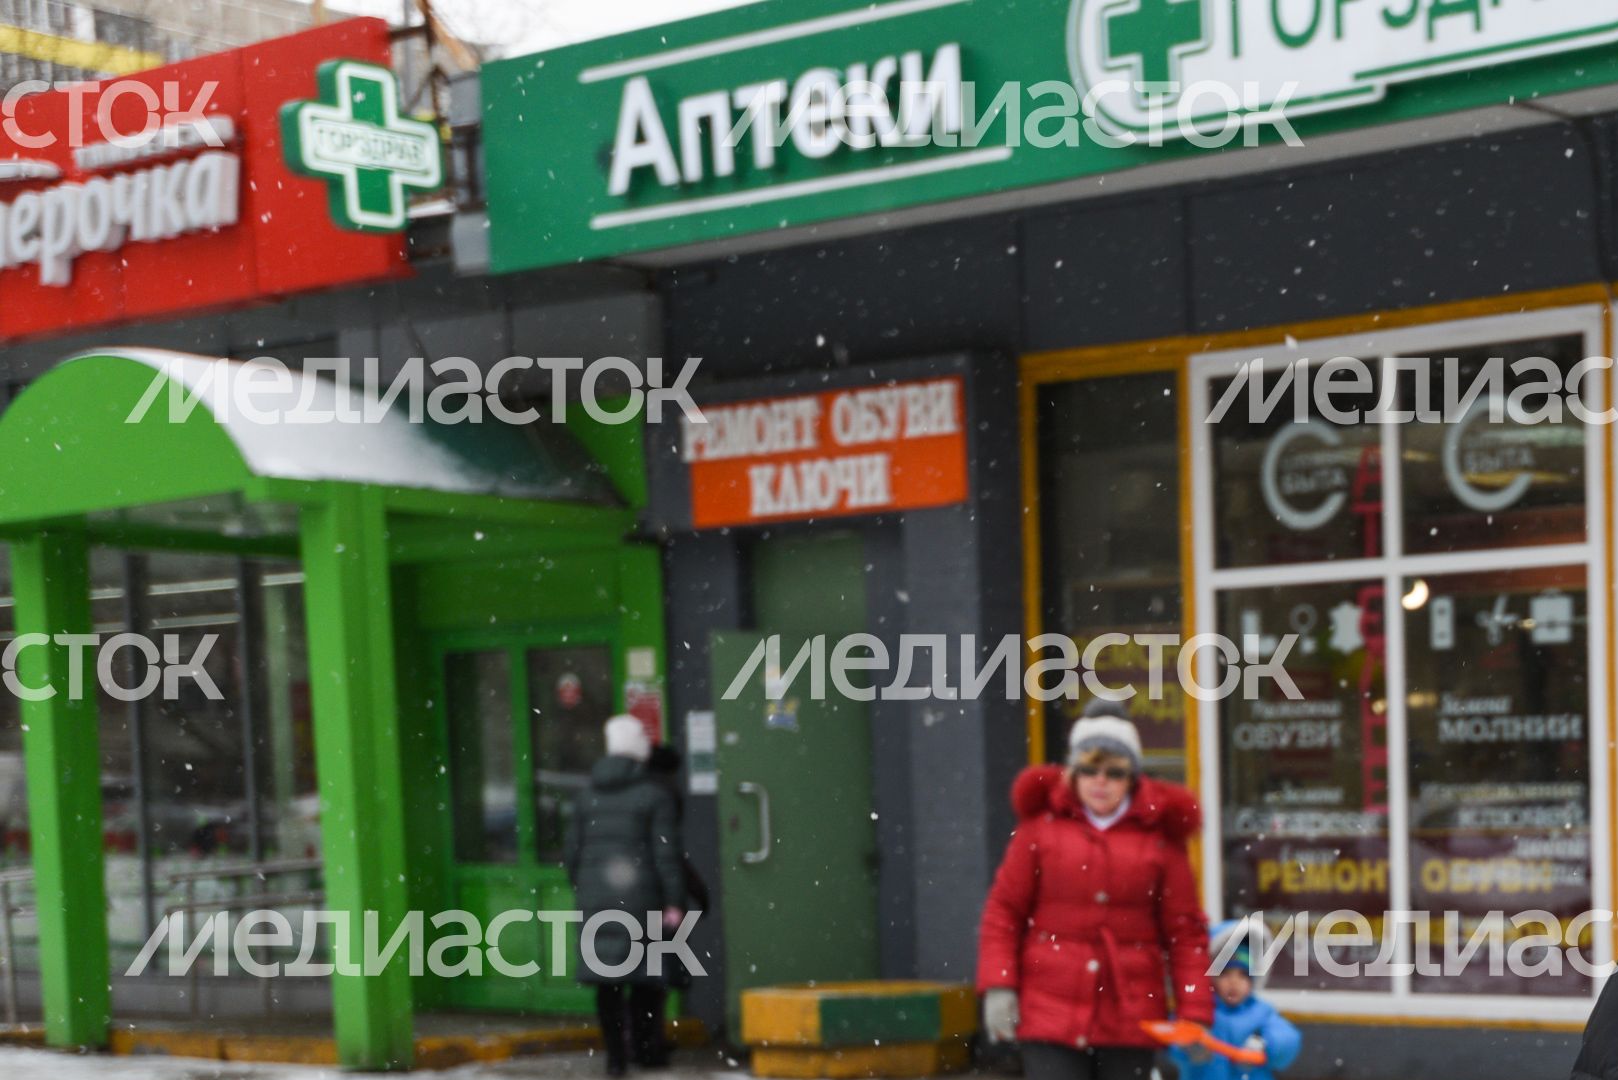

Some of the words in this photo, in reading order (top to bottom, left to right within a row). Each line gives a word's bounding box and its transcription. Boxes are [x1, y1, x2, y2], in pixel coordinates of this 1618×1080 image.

[606, 42, 963, 196] Аптеки
[0, 152, 241, 285] ерочка
[680, 395, 821, 463] РЕМОНТ
[831, 379, 960, 447] ОБУВИ
[746, 452, 893, 517] КЛЮЧИ
[1232, 721, 1341, 750] ОБУВИ
[1256, 858, 1389, 895] РЕМОН
